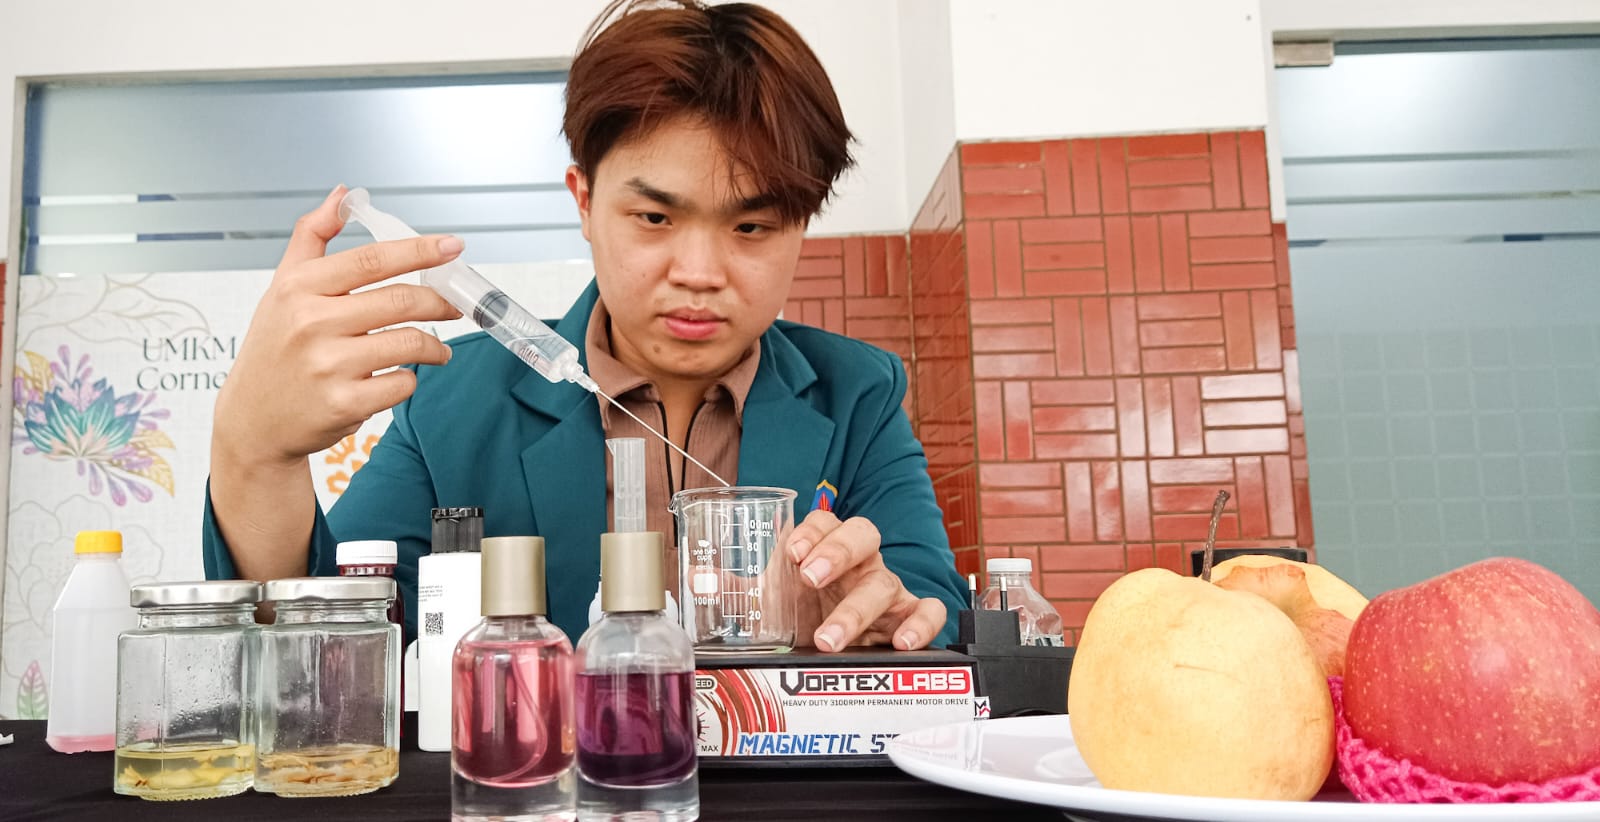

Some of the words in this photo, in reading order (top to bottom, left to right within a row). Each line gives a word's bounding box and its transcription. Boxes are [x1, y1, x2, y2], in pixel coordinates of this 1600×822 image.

[143, 336, 235, 361] UMKM
[137, 367, 228, 391] Corne
[746, 542, 758, 551] 80
[747, 565, 760, 574] 60
[747, 587, 761, 597] 40
[748, 611, 761, 620] 20
[780, 672, 891, 696] VORTEX
[897, 673, 966, 691] LABS
[867, 698, 914, 706] PERMANENT
[916, 698, 943, 706] MOTOR
[738, 734, 861, 754] MAGNETIC
